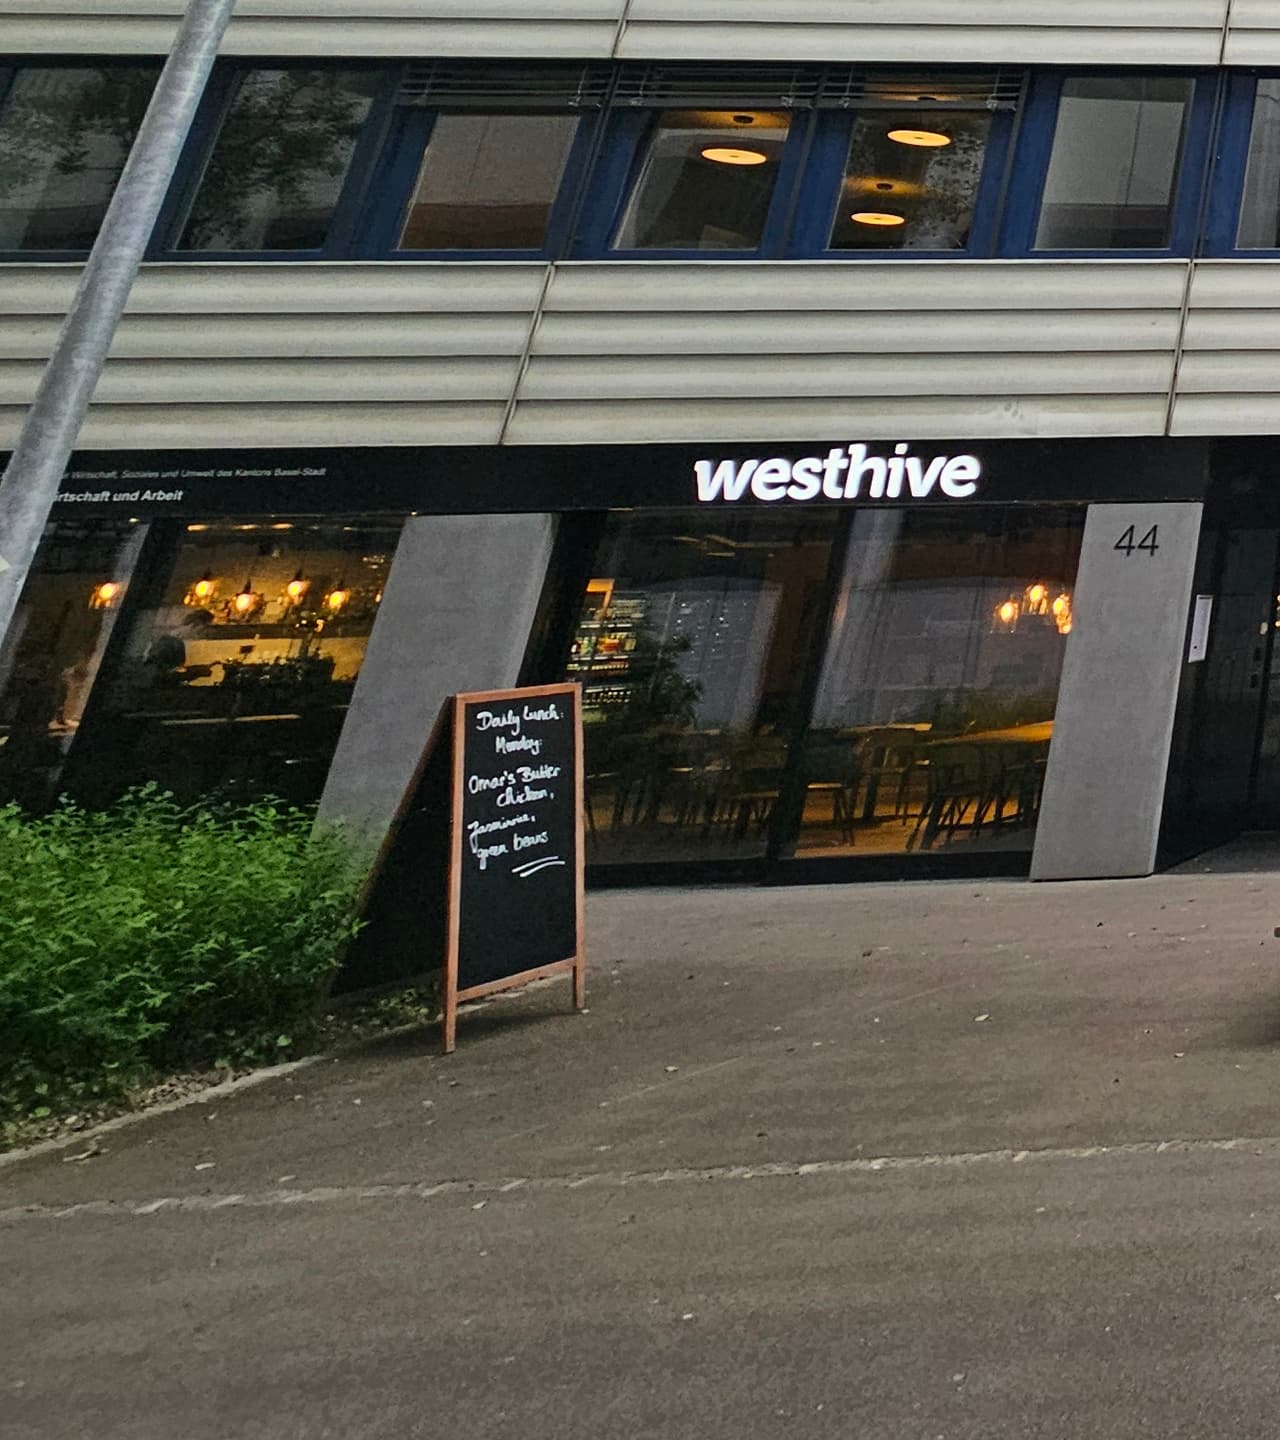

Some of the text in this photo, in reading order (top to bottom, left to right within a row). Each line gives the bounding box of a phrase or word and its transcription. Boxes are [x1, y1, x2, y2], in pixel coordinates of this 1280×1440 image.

[694, 443, 981, 501] westhive
[58, 489, 184, 502] rtschaft und Arbeit
[1113, 524, 1159, 557] 44
[476, 709, 520, 736] Daily
[468, 770, 516, 794] Omar's
[513, 831, 549, 851] beans
